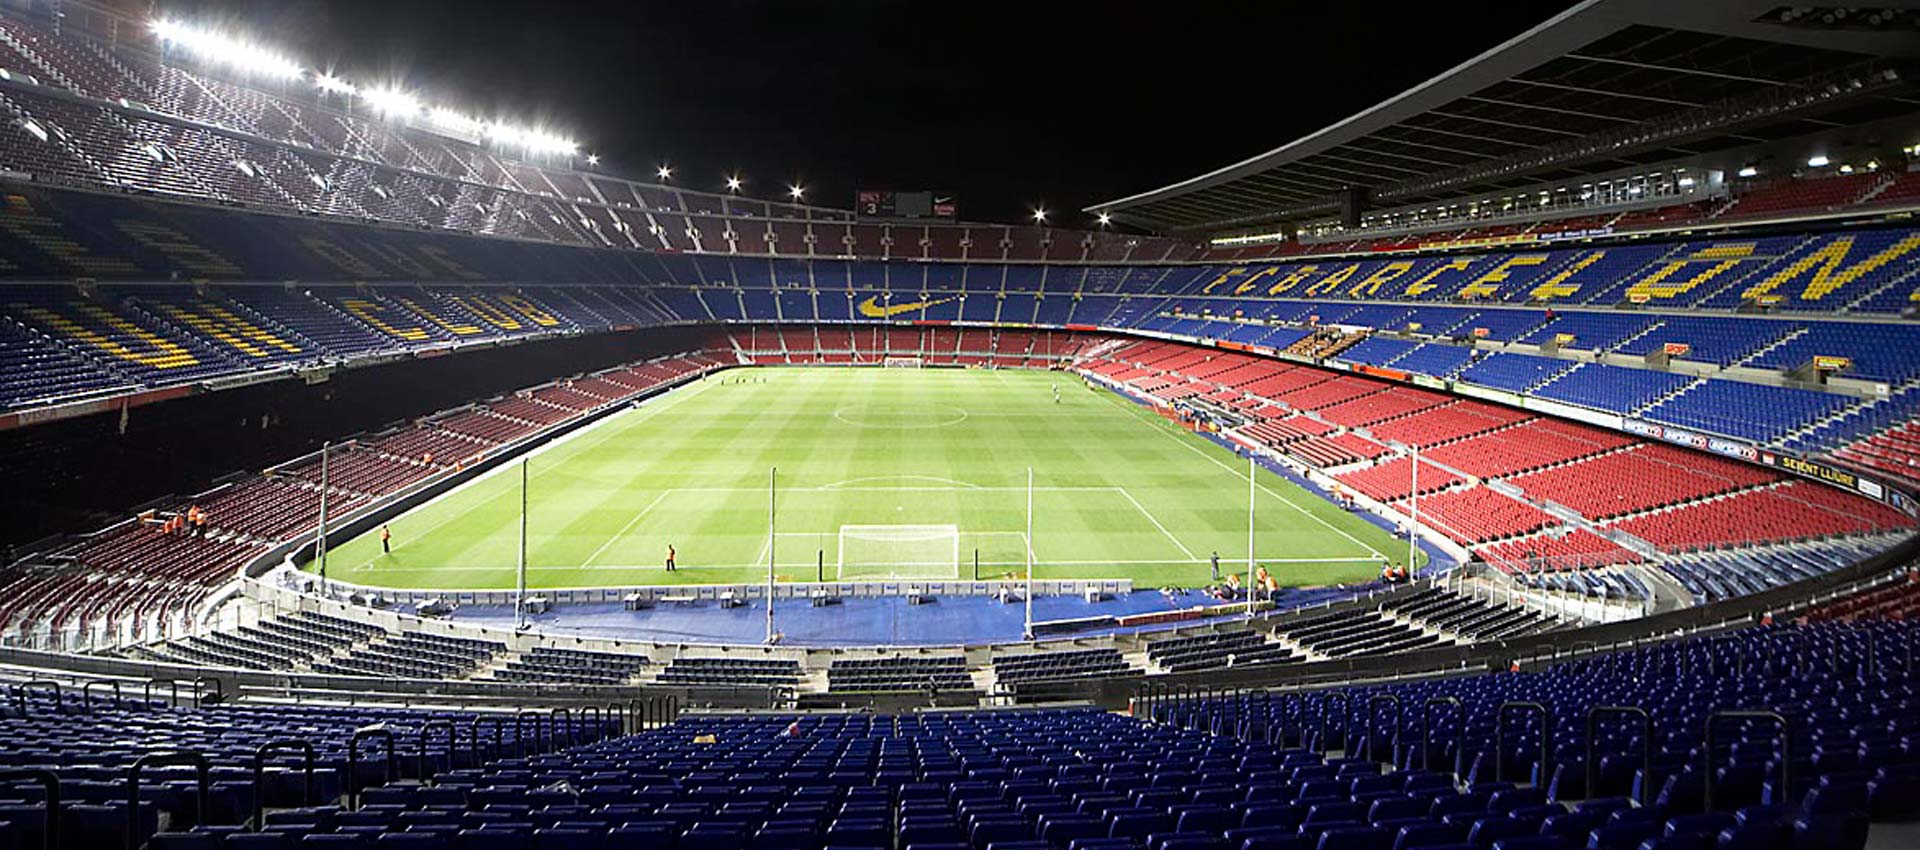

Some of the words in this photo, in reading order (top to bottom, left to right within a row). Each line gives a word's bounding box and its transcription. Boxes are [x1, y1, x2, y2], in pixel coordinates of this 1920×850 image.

[867, 202, 876, 214] 3
[1268, 233, 1920, 300] BARCELON
[342, 294, 560, 341] CLUB
